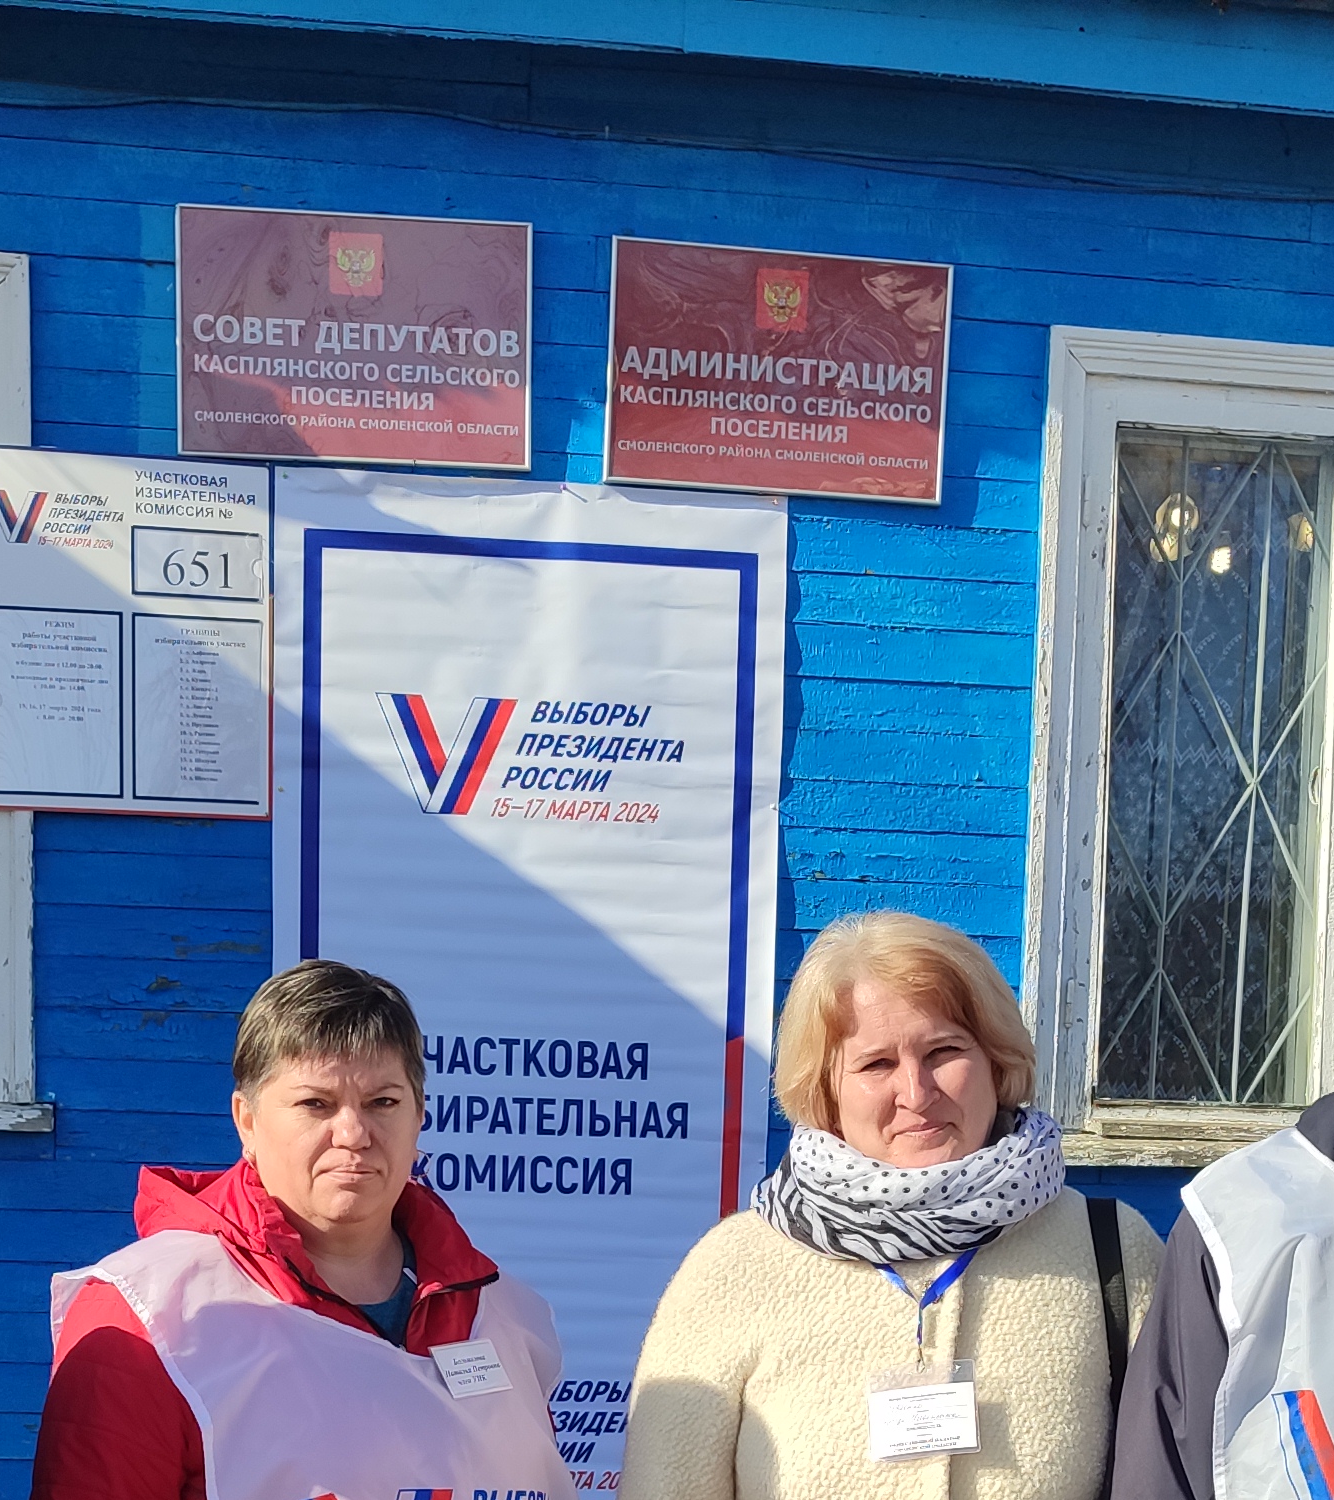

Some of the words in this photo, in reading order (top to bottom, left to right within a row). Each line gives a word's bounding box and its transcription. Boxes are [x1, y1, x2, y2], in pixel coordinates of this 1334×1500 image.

[193, 313, 306, 347] СОВЕТ
[315, 321, 520, 358] ДЕПУТАТОВ
[194, 353, 379, 382] КАСПЛЯНСКОГО
[386, 363, 520, 388] СЕЛЬСКОГО
[621, 346, 933, 397] АДМИНИСТРАЦИЯ
[291, 386, 434, 411] ПОСЕЛЕНИЯ
[619, 384, 796, 415] КАСПЛЯНСКОГО
[804, 396, 932, 423] СЕЛЬСКОГО
[194, 410, 297, 426] СМОЛЕНСКОГО
[301, 412, 356, 429] РАЙОНА
[360, 417, 453, 434] СМОЛЕНСКОЙ
[457, 422, 519, 437] ОБЛАСТИ
[710, 417, 847, 443] ПОСЕЛЕНИЯ
[618, 439, 715, 456] СМОЛЕНСКОГО
[719, 443, 772, 459] РАЙОНА
[776, 448, 865, 465] СМОЛЕНСКОЙ
[869, 455, 928, 470] ОБЛАСТИ
[134, 470, 228, 488] УЧАСТКОВАЯ
[54, 493, 109, 507] ВЫБОРЫ
[135, 487, 256, 506] ИЗБИРАТЕЛЬНАЯ
[48, 508, 125, 523] ПРЕЗИДЕНТА
[135, 502, 214, 518] КОМИССИЯ
[218, 507, 233, 519] №
[42, 522, 91, 535] РОССИИ
[64, 538, 92, 549] МАРТА
[162, 549, 233, 589] 651
[530, 700, 651, 728] ВЫБОРЫ
[516, 733, 685, 763] ПРЕЗИДЕНТА
[501, 766, 612, 792] РОССИИ
[545, 801, 609, 823] МАРТА
[613, 801, 661, 824] 2024
[422, 1035, 649, 1081] ЧАСТКОВАЯ
[421, 1094, 689, 1139] БИРАТЕЛЬНАЯ
